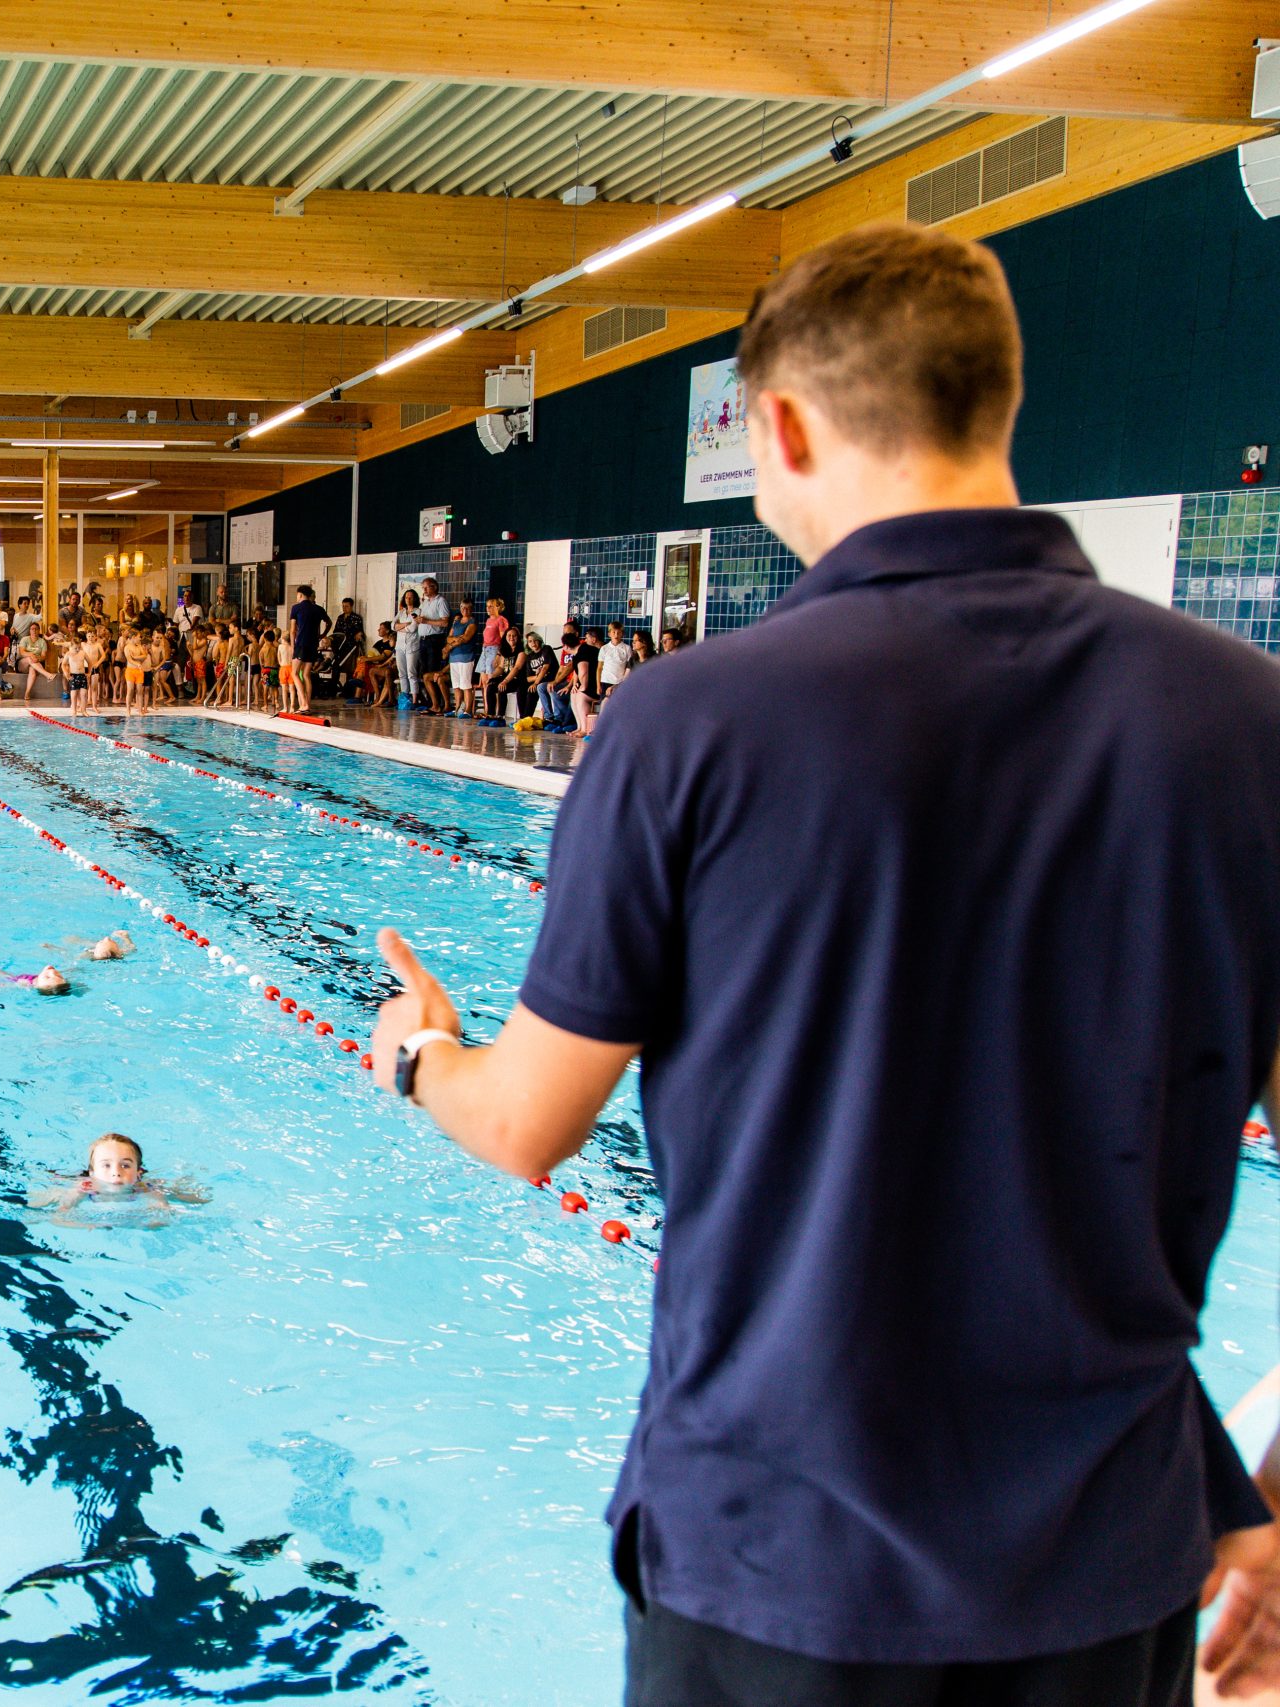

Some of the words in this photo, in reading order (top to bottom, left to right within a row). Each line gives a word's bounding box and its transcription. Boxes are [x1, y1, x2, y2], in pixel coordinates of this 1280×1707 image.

[700, 474, 713, 483] LEER
[713, 470, 742, 481] ZWEMMEN
[743, 468, 756, 478] MET
